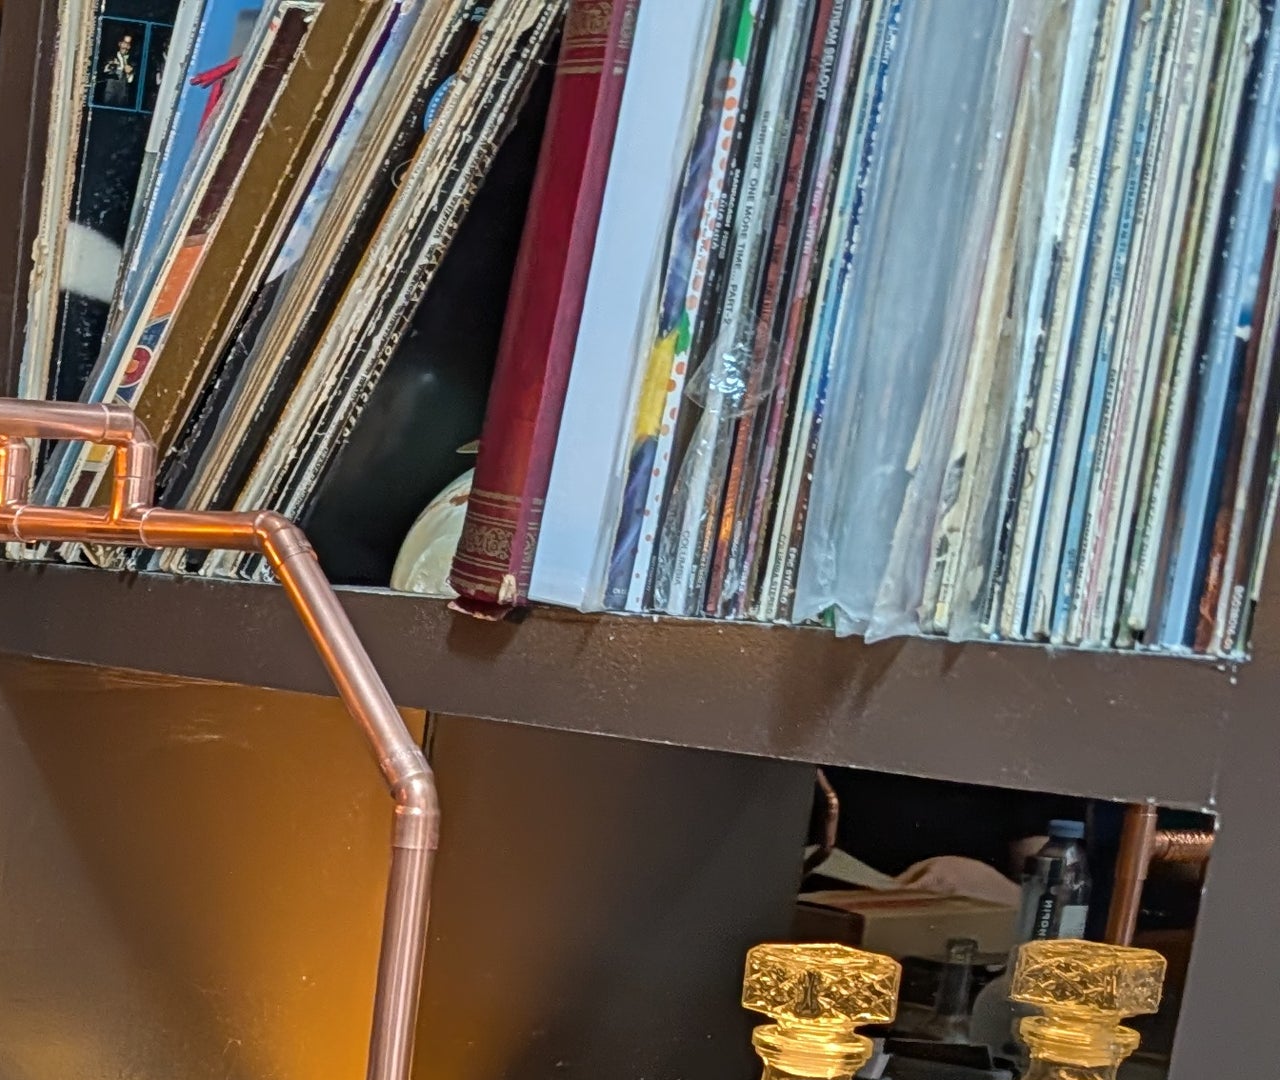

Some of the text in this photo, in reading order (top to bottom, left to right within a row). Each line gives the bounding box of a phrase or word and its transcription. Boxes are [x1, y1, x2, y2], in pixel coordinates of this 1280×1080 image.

[814, 47, 834, 100] SELLOUT
[745, 178, 757, 201] ONE
[738, 205, 752, 239] MORE
[722, 284, 738, 324] PART-2
[341, 332, 401, 437] COLLECTED
[673, 530, 690, 585] COLUMBIA
[779, 569, 792, 603] STEREO
